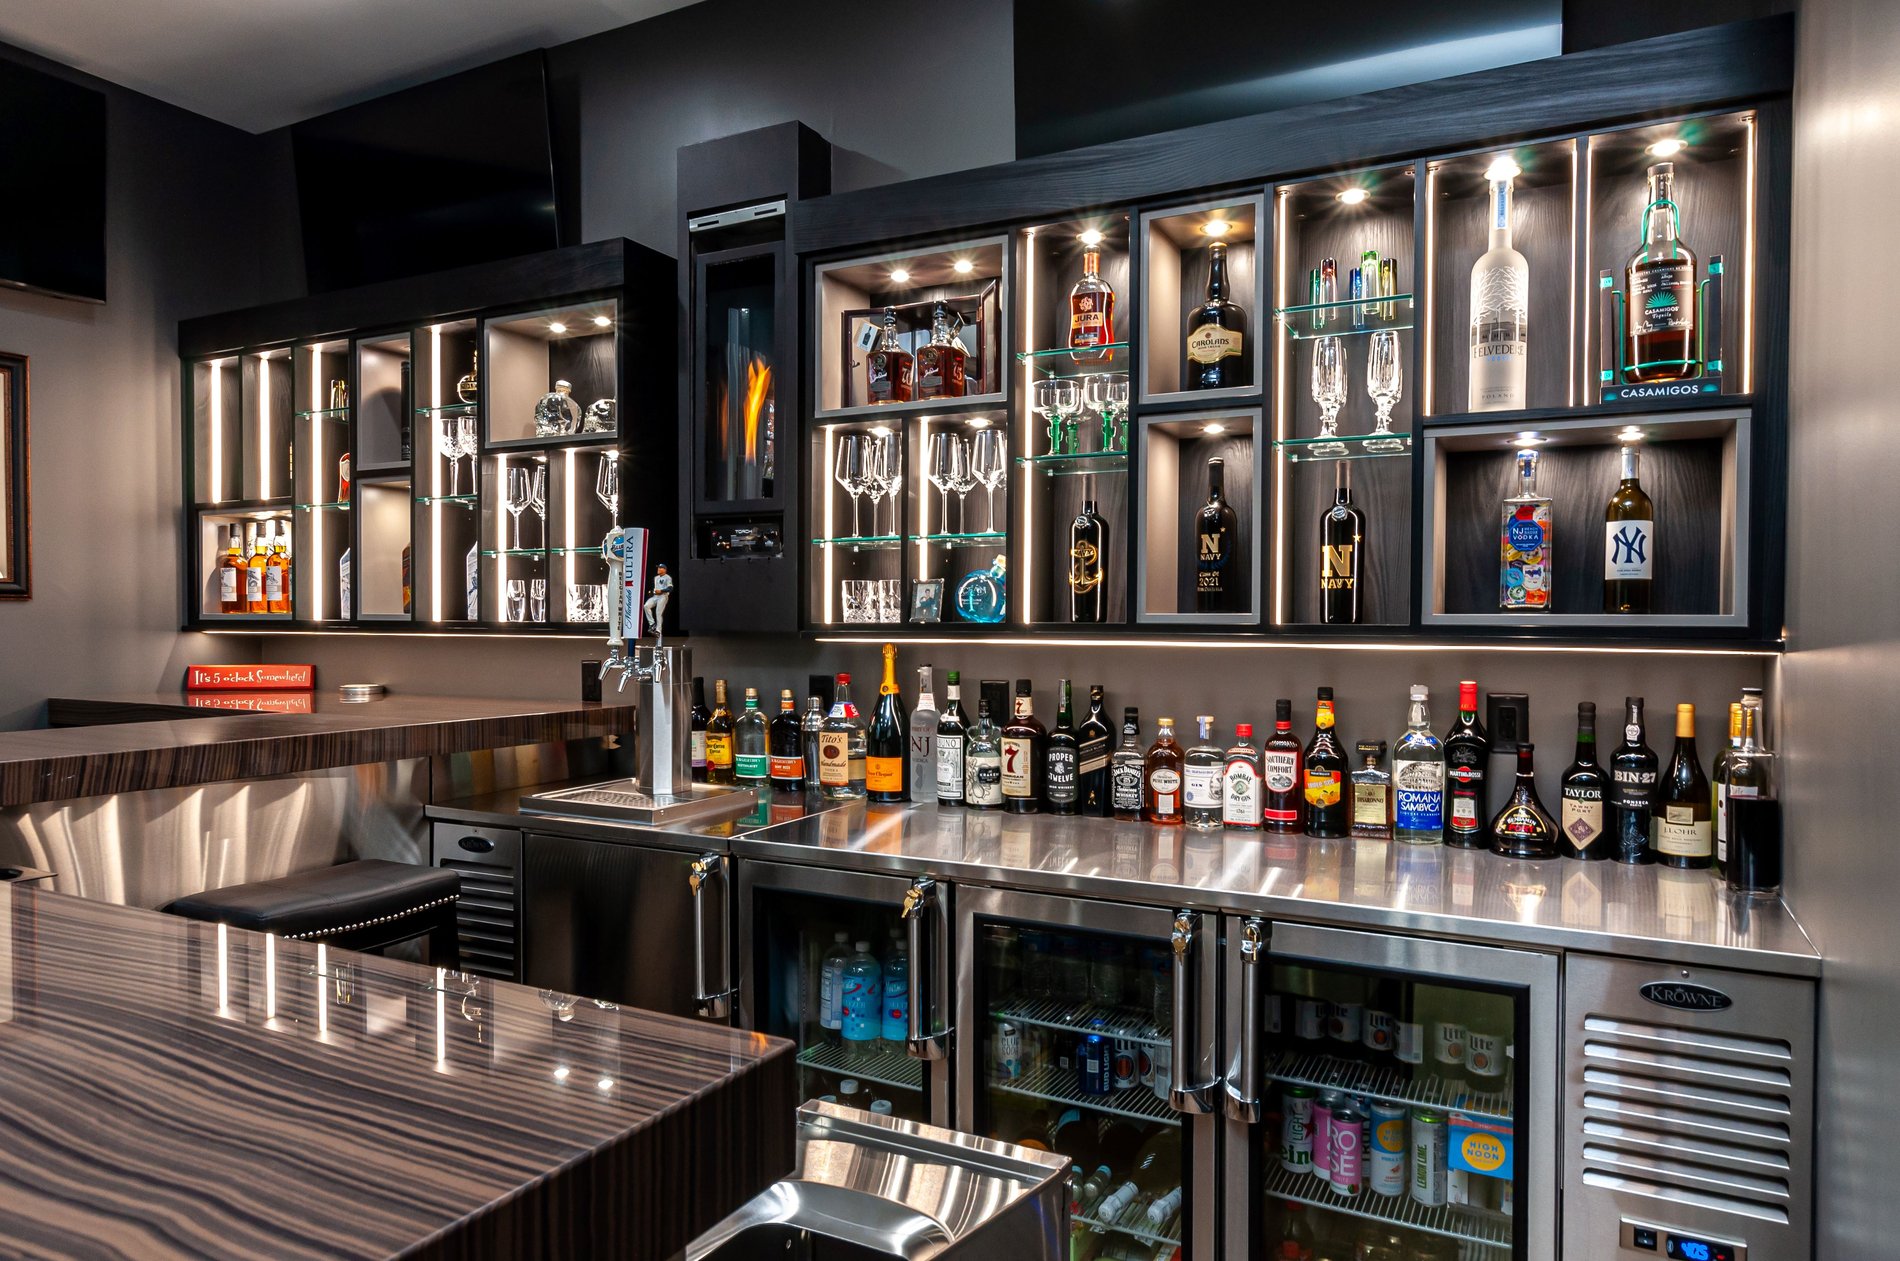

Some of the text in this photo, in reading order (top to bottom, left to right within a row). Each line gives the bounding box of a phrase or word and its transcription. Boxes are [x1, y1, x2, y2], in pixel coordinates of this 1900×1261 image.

[1074, 314, 1099, 322] JURA
[1621, 385, 1699, 398] CASAMIGOS
[1201, 533, 1220, 553] N
[625, 536, 634, 579] ULTRA
[1321, 544, 1353, 577] N
[1199, 577, 1219, 586] 2021
[1321, 578, 1354, 589] NAVY
[194, 669, 306, 685] It's 5 o'clock Somewhere!
[821, 734, 842, 743] Tito's
[911, 736, 930, 757] NJ
[1004, 745, 1019, 773] 7
[1049, 753, 1074, 763] PROPER
[1266, 755, 1295, 765] SOUTHERN
[1267, 764, 1293, 773] COMFORT
[1049, 772, 1073, 783] TWELVE
[1229, 773, 1252, 784] BOMBAY
[1398, 792, 1440, 802] ROMANA
[1564, 787, 1602, 798] TAYLOR
[1508, 824, 1534, 832] PORT
[1650, 986, 1722, 1007] KROWNE
[1470, 1141, 1498, 1152] HIGH
[1467, 1148, 1499, 1160] NOON
